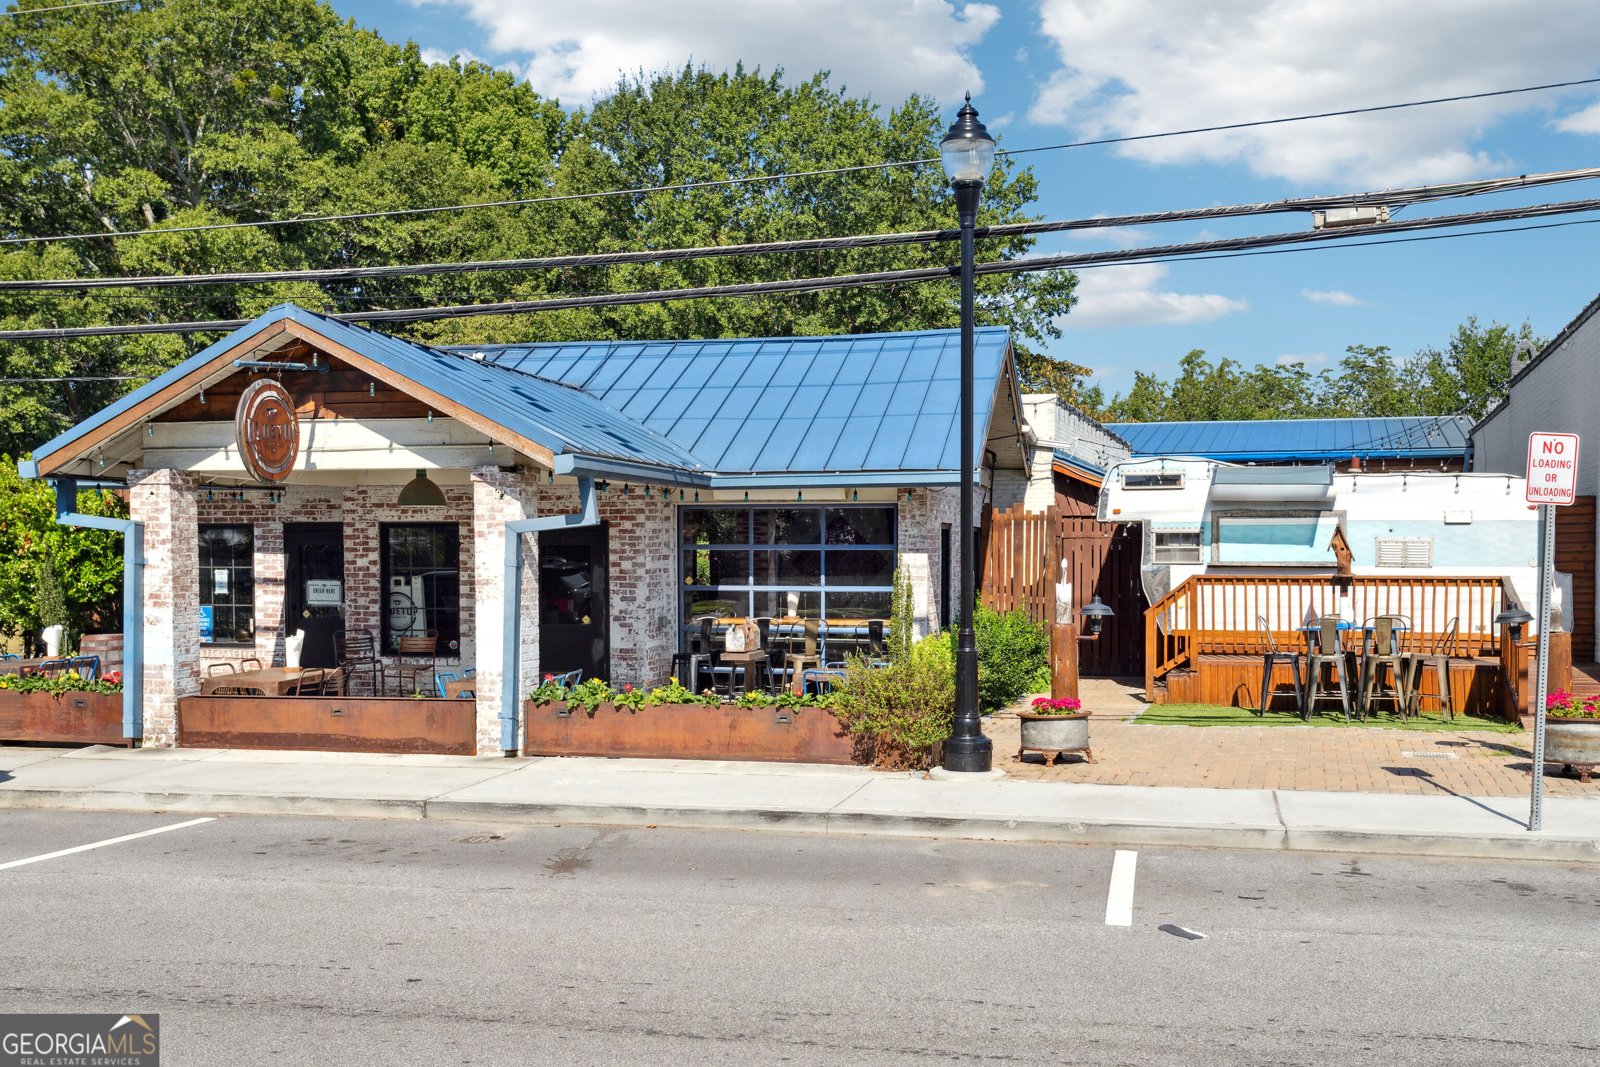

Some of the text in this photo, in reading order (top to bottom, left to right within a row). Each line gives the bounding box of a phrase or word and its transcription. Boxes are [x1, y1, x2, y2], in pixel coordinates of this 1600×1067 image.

[1542, 441, 1564, 454] NO
[1532, 459, 1571, 469] LOADING
[1545, 473, 1557, 482] OR
[1529, 487, 1571, 497] UNLOADING
